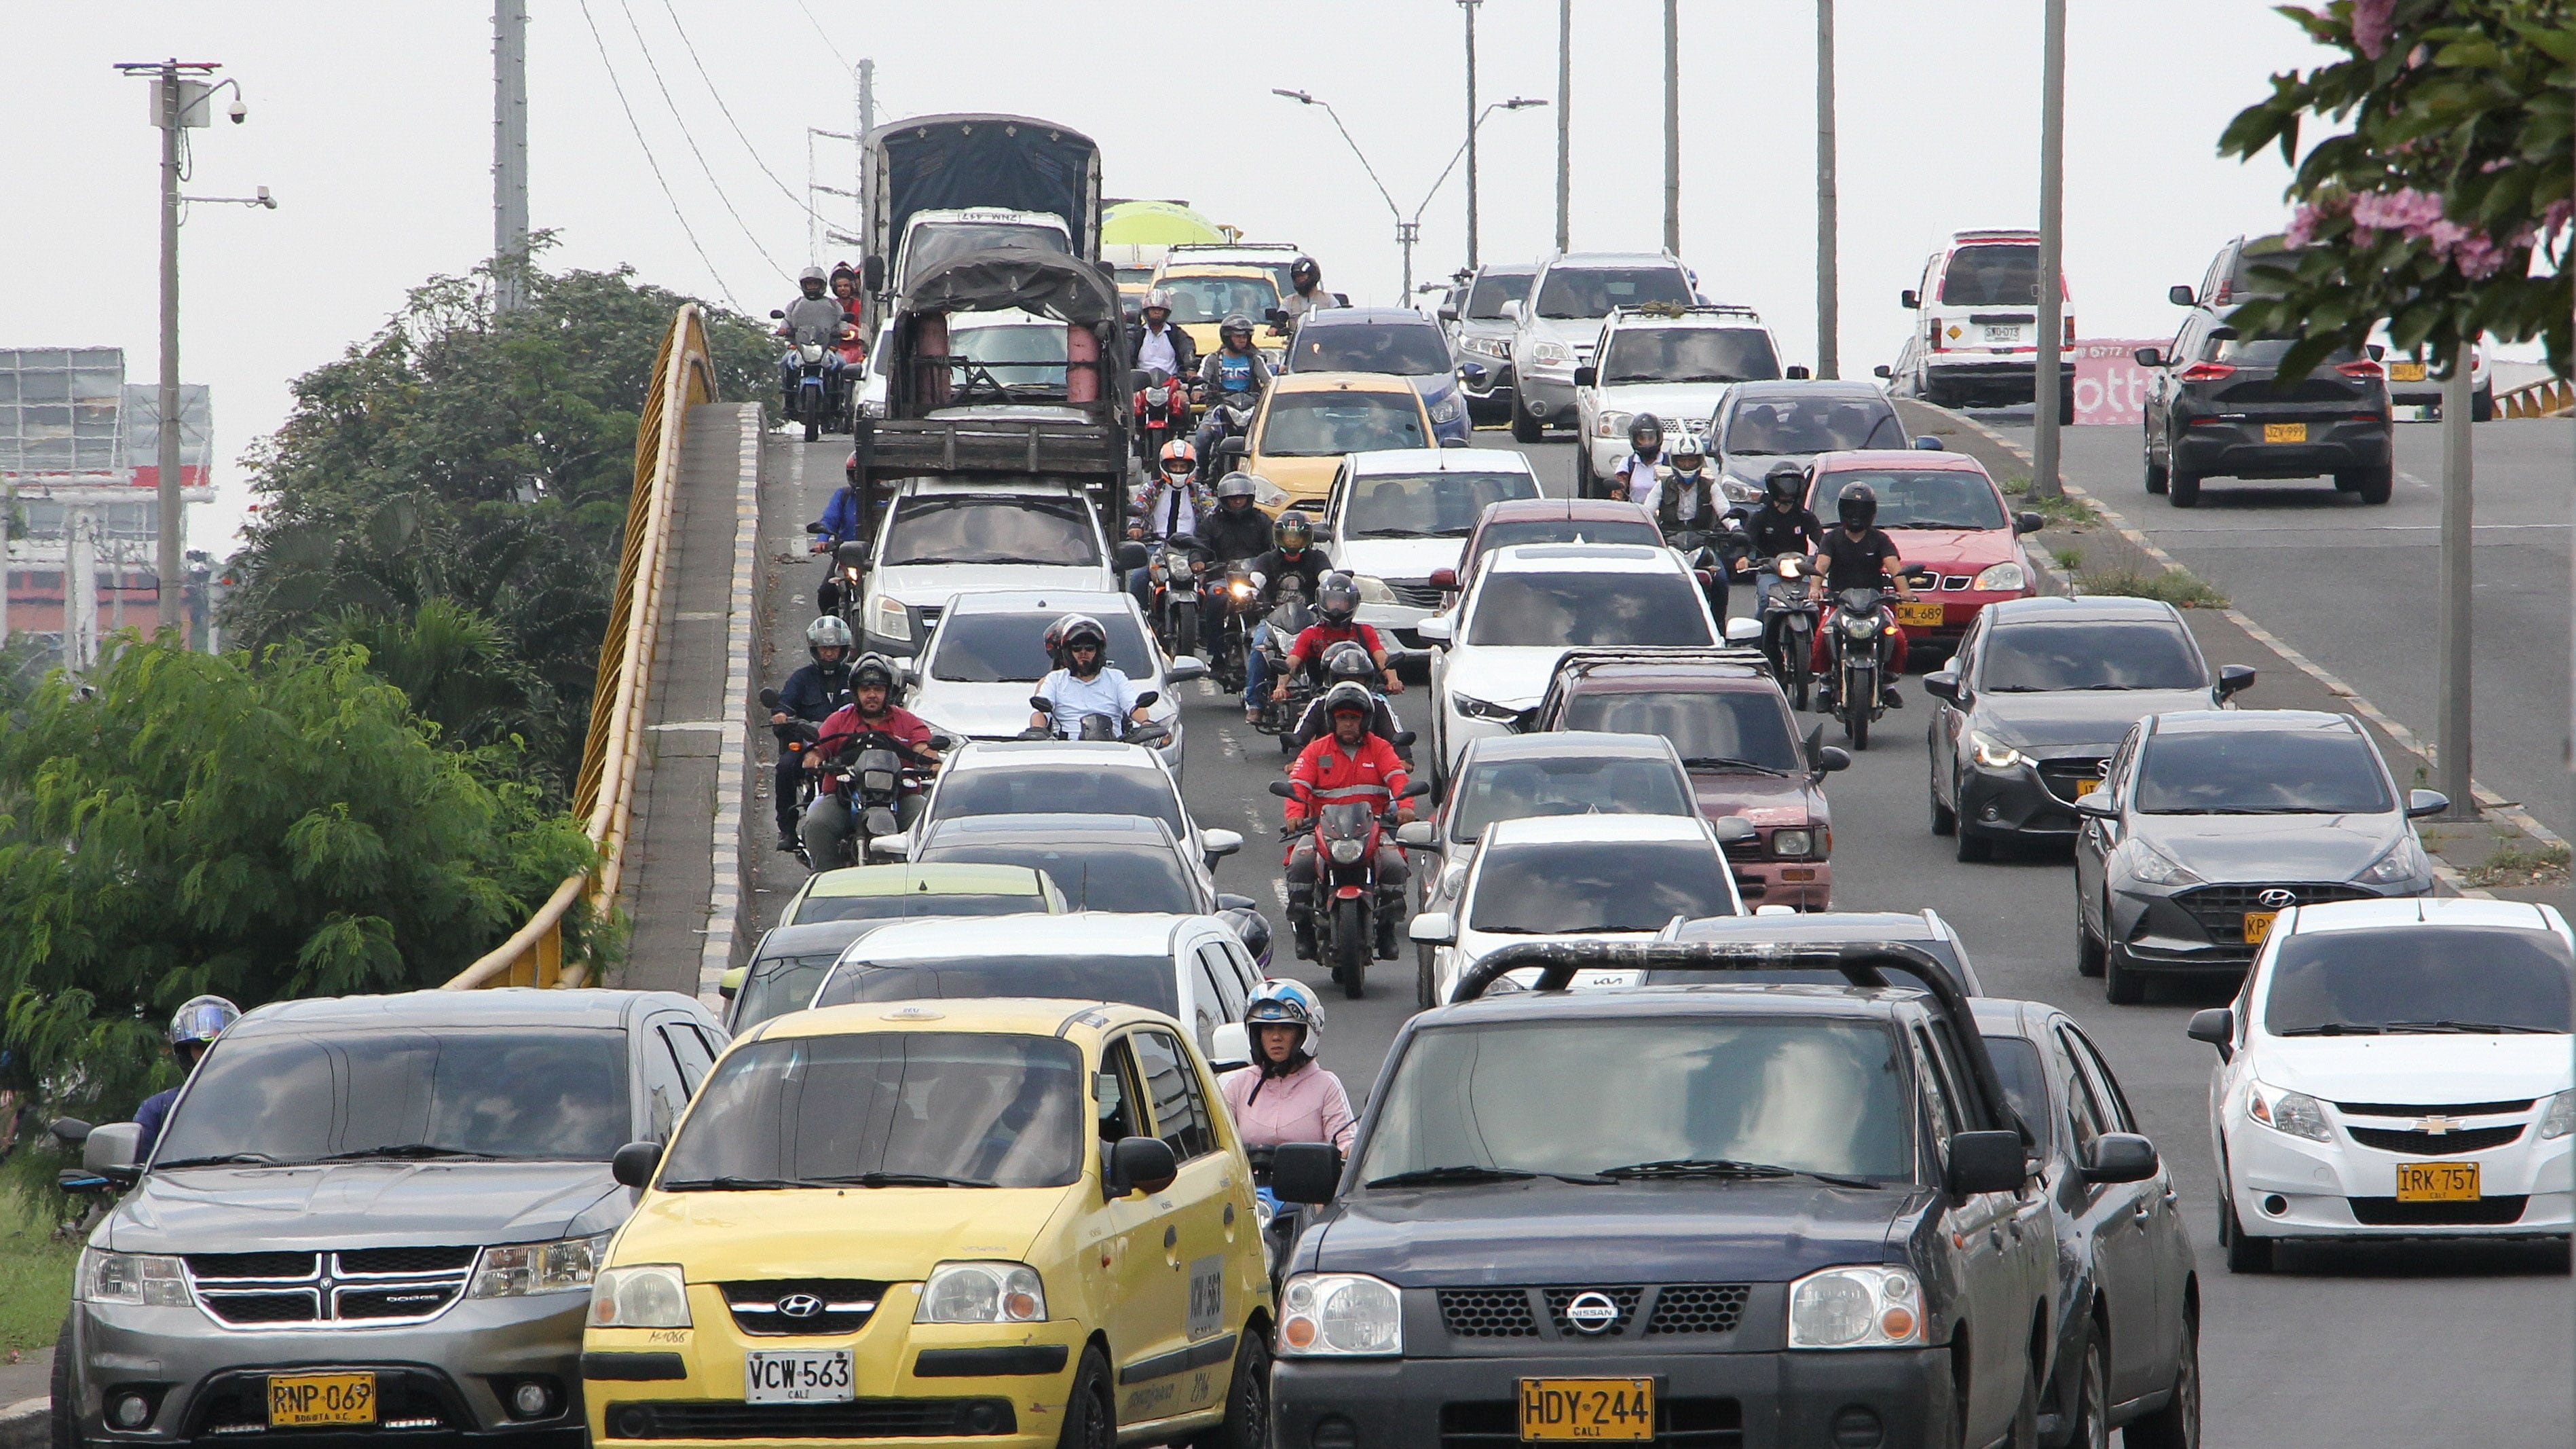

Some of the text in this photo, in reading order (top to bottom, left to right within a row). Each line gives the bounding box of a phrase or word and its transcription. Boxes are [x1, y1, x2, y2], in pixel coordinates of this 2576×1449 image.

[2247, 918, 2271, 935] KP
[386, 1294, 439, 1302] DODGE
[1572, 1309, 1613, 1317] NISSAN
[787, 1389, 810, 1399] CALI
[1573, 1427, 1601, 1436] CALI
